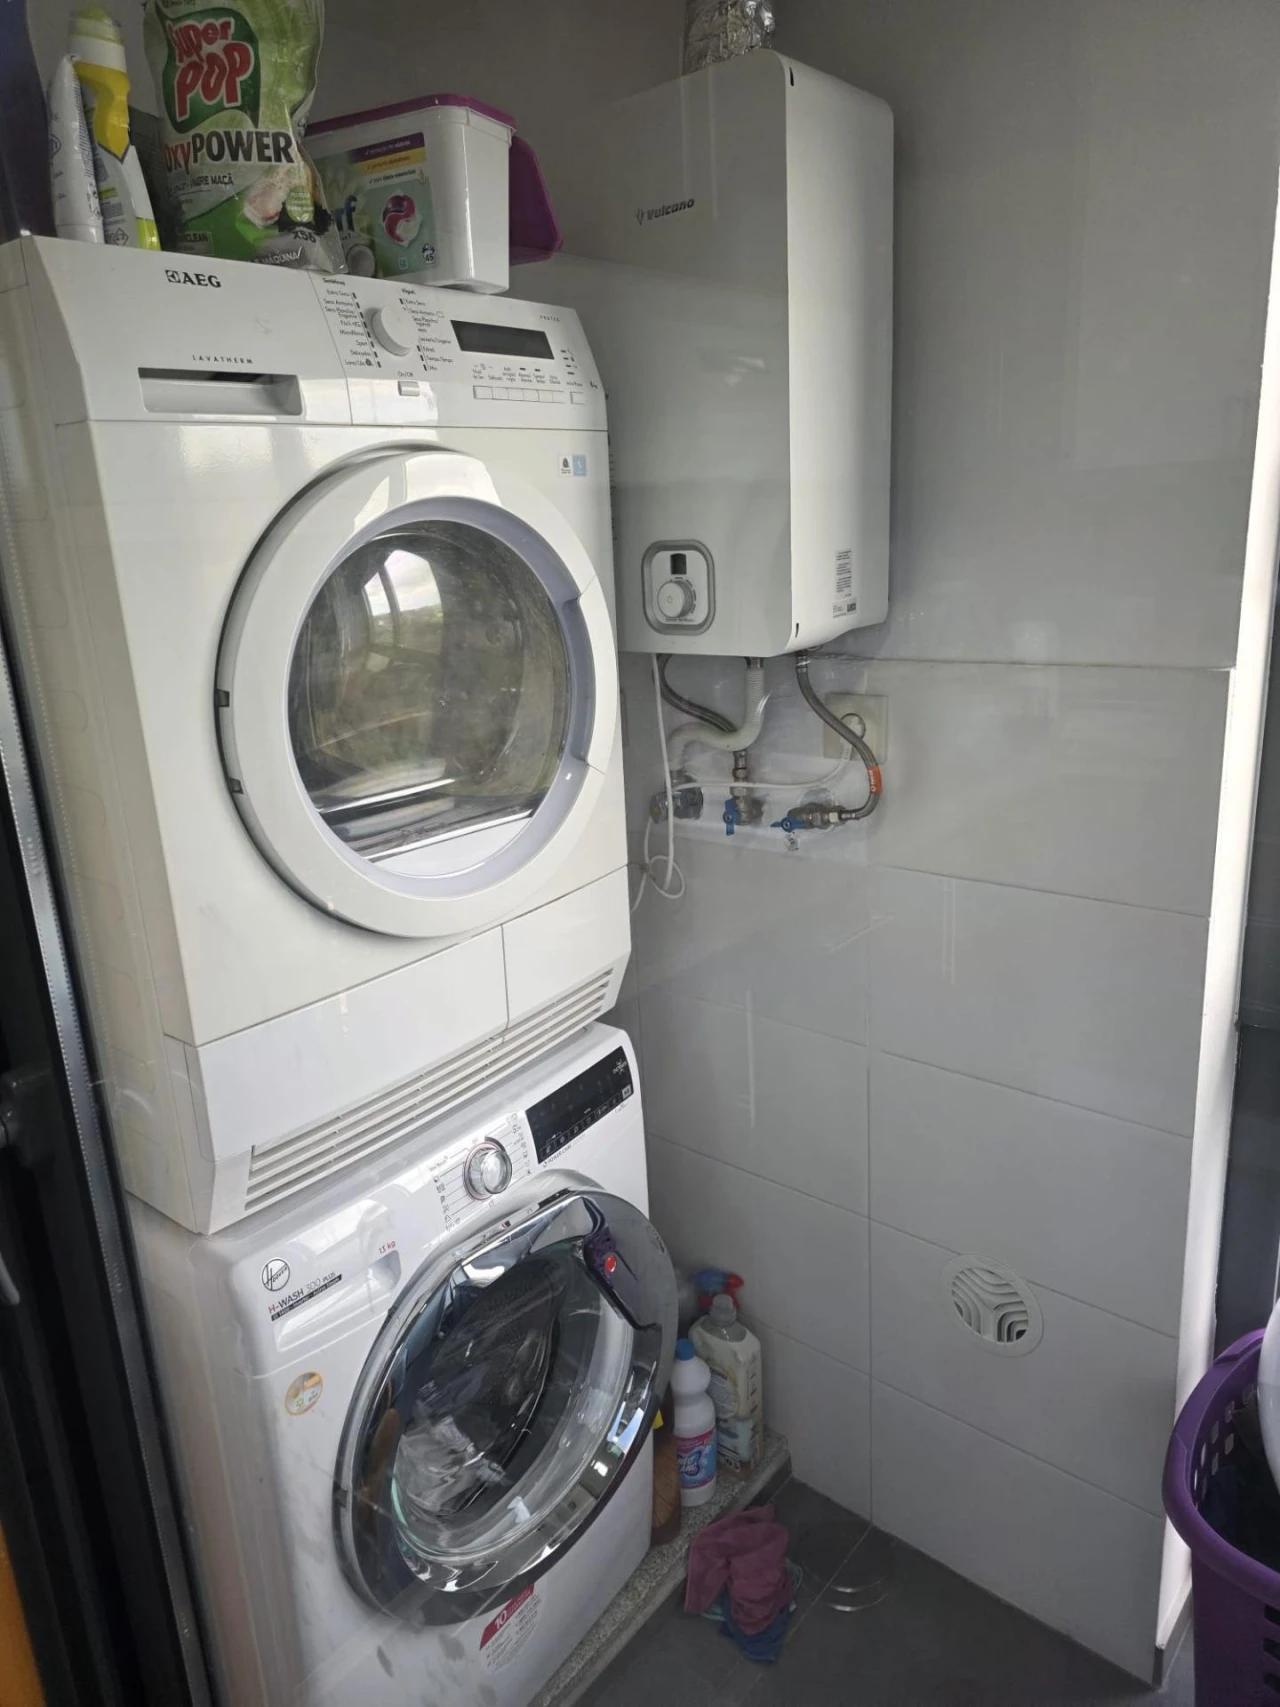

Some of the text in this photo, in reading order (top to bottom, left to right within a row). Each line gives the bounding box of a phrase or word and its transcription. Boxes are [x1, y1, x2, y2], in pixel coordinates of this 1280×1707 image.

[646, 198, 695, 221] Vulcano
[182, 271, 222, 289] AEG
[192, 354, 254, 364] LAVATHERM
[267, 1288, 305, 1314] H-WASH
